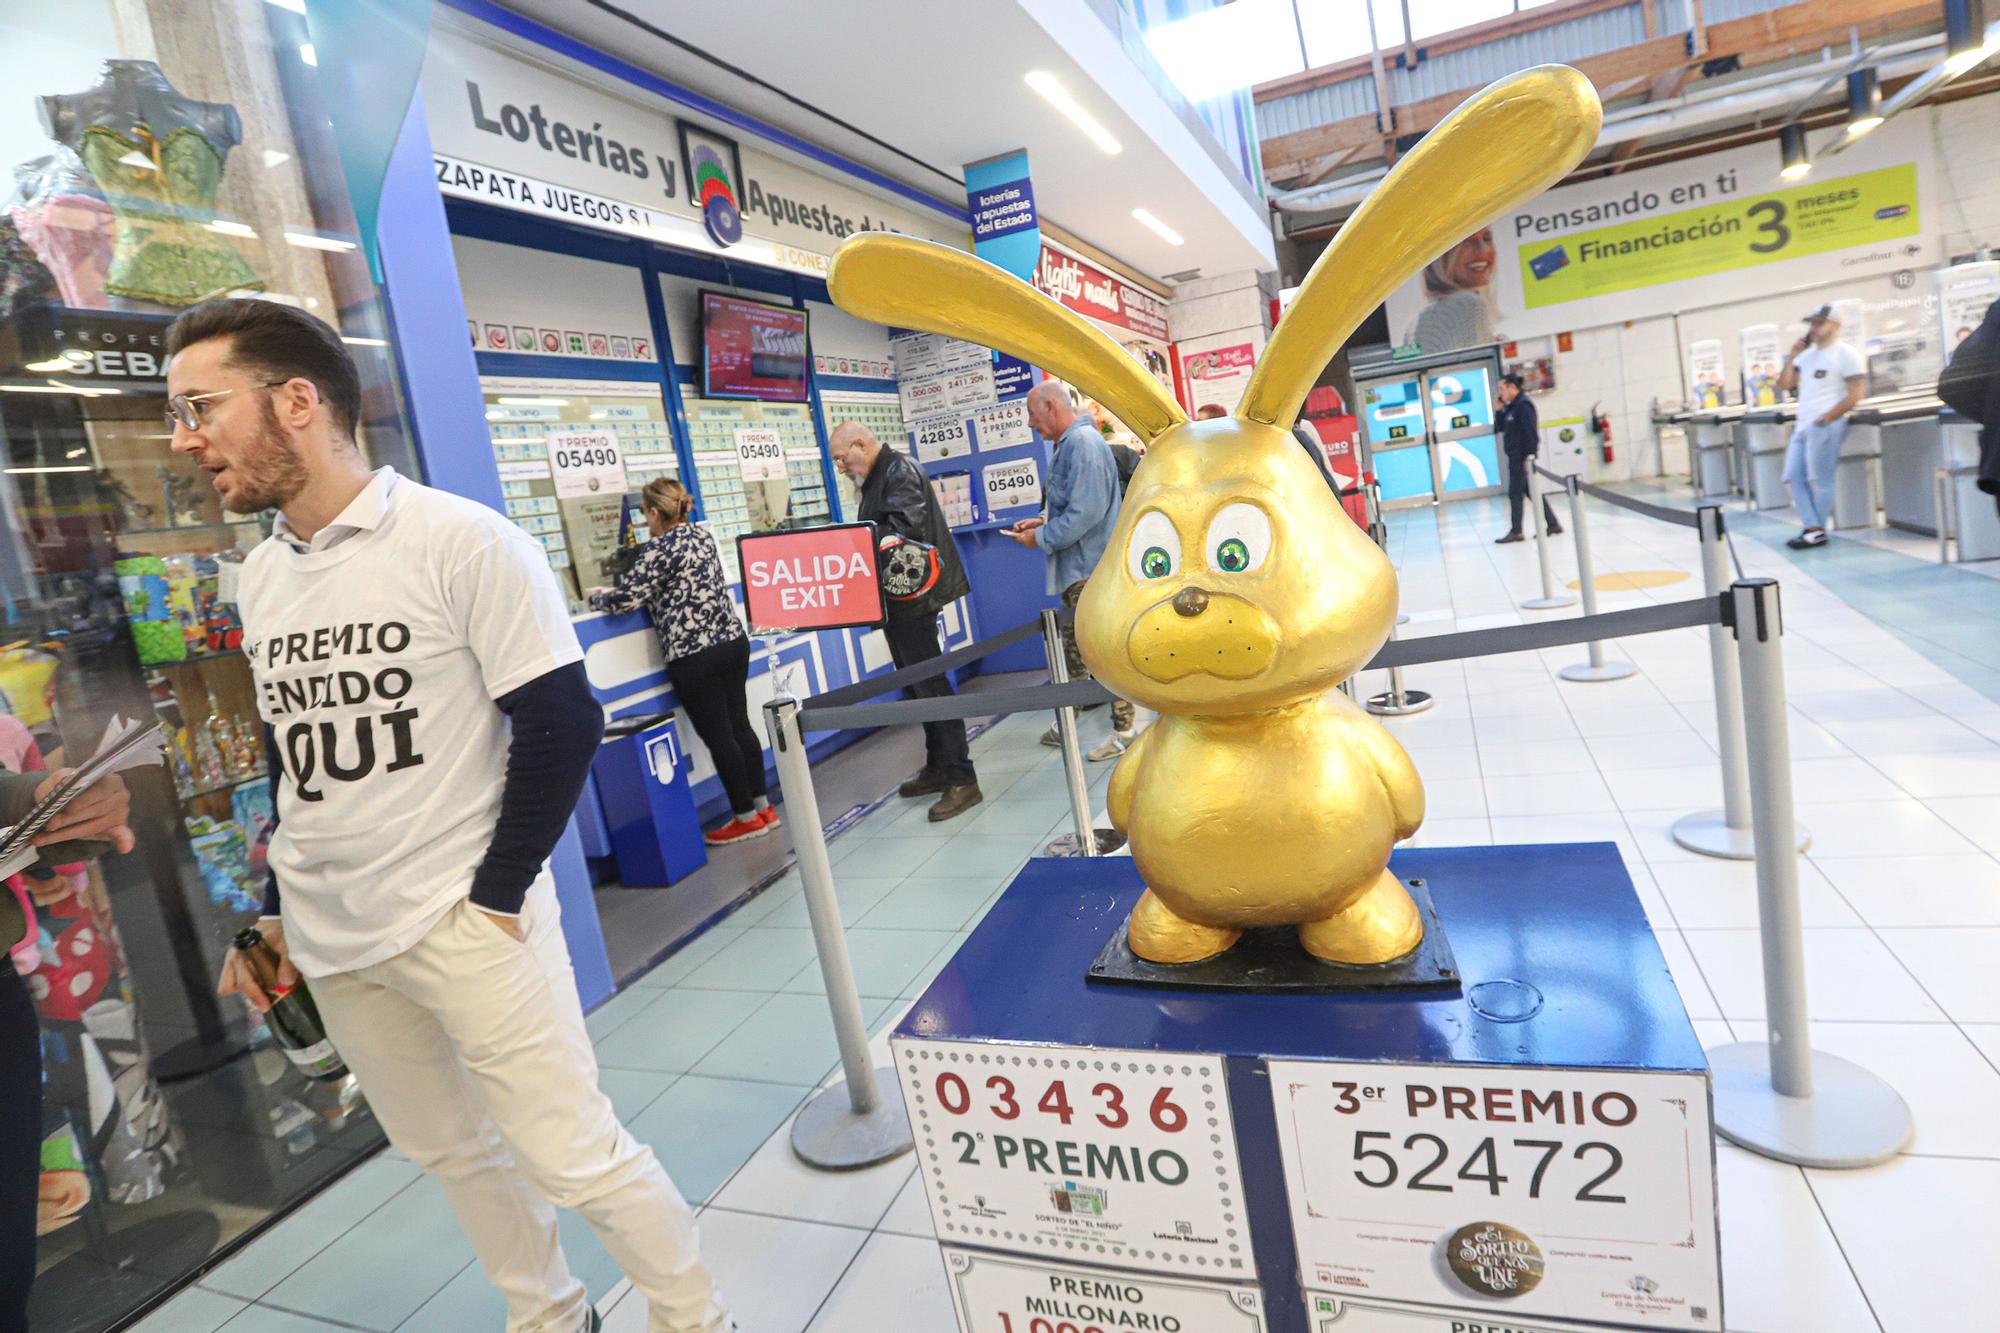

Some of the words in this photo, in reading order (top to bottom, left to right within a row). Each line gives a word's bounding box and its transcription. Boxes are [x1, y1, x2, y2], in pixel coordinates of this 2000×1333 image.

[465, 80, 649, 179] Loterías
[658, 155, 676, 198] y
[747, 179, 854, 239] Apuestas
[434, 159, 535, 205] ZAPATA
[543, 187, 623, 225] JUEGOS
[1514, 190, 1660, 238] Pensando
[1669, 182, 1707, 205] en
[1716, 168, 1738, 195] ti
[1796, 187, 1860, 209] meses
[973, 212, 981, 224] y
[982, 199, 1031, 219] apuestas
[976, 221, 993, 234] del
[994, 212, 1032, 230] Estado
[1578, 213, 1742, 264] Financiación
[1746, 200, 1791, 254] 3
[1841, 251, 1893, 268] Carrefour
[1041, 246, 1086, 304] light
[1084, 279, 1119, 313] nails
[928, 419, 960, 431] PREMIO
[980, 407, 1022, 423] 44469
[990, 419, 1023, 433] PREMIO
[566, 436, 609, 448] PREMIO
[747, 433, 775, 443] PREMIO
[920, 426, 964, 446] 42833
[1327, 440, 1348, 451] URO
[556, 448, 617, 469] 05490
[740, 443, 780, 460] 05490
[988, 474, 1035, 492] 05490
[996, 466, 1030, 478] PREMIO
[750, 552, 872, 588] SALIDA
[780, 583, 845, 611] EXIT
[268, 621, 411, 669] PREMIO
[273, 701, 425, 803] QUÍ
[935, 1071, 1189, 1134] 03436
[1332, 1081, 1386, 1115] 3er
[1405, 1084, 1638, 1128] PREMIO
[993, 1134, 1190, 1187] PREMIO
[1353, 1130, 1627, 1205] 52472
[1035, 1213, 1067, 1227] SORTEO
[1068, 1217, 1079, 1227] DE
[1183, 1235, 1218, 1246] Nacional
[1460, 1237, 1529, 1262] SORTEO
[1477, 1254, 1502, 1268] QUE
[1503, 1253, 1530, 1271] NOS
[1049, 1275, 1143, 1304] PREMIO
[1472, 1264, 1518, 1290] UNE
[1025, 1296, 1182, 1333] MILLONARIO
